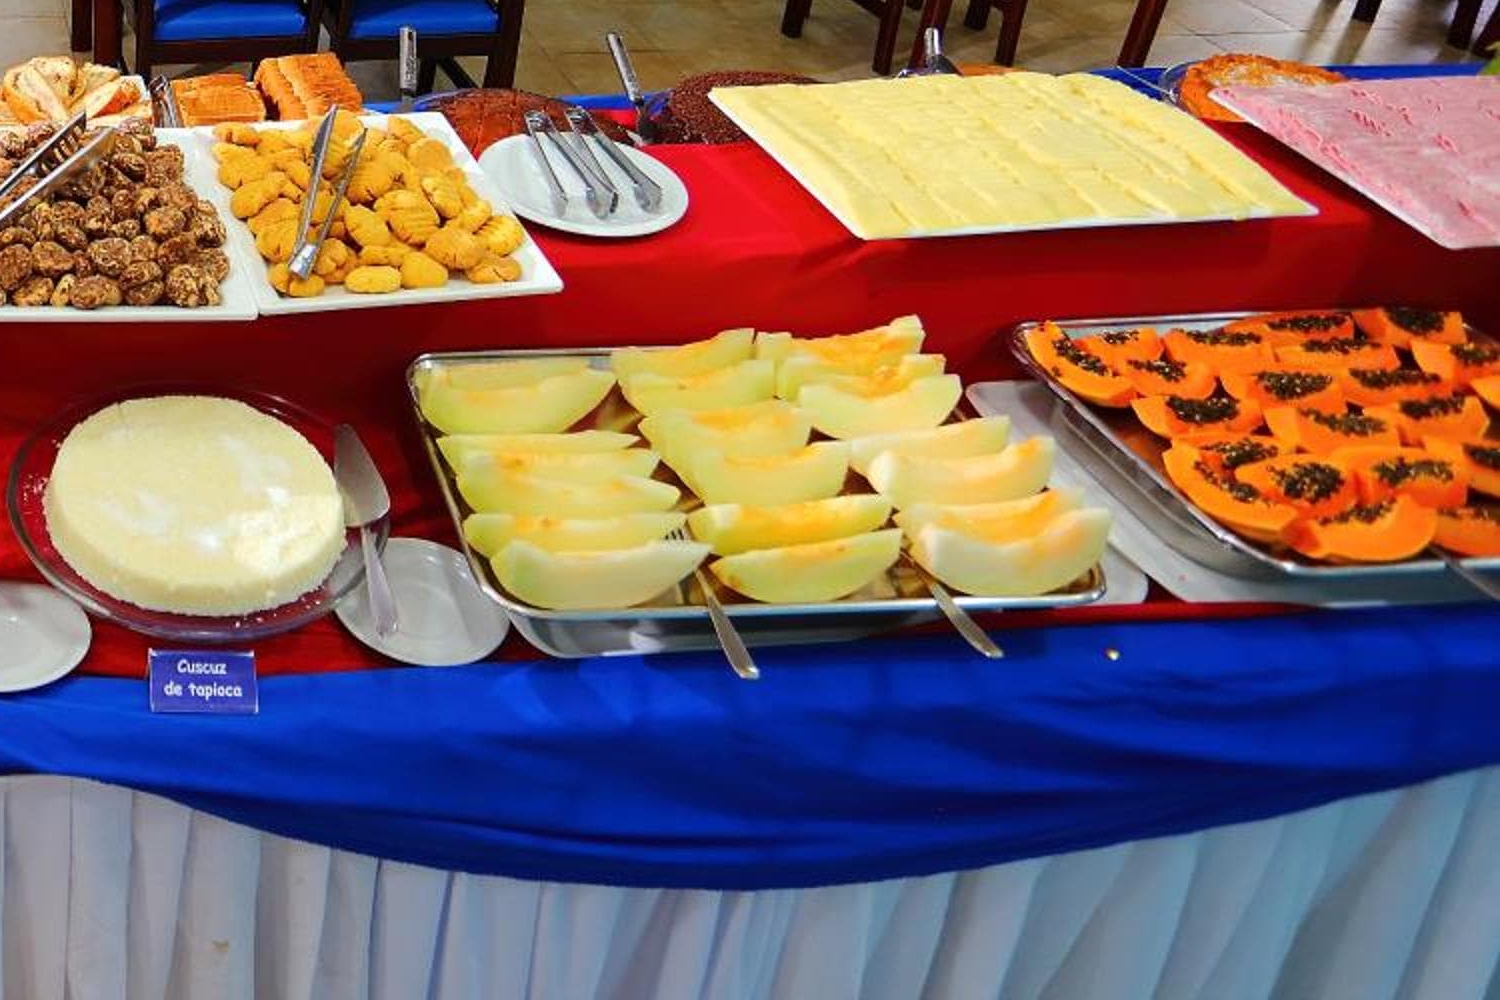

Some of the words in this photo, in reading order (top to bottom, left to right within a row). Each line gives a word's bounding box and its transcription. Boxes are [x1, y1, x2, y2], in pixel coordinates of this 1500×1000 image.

[177, 659, 227, 675] Cuscuz
[163, 680, 183, 696] de
[188, 682, 243, 701] tapioca
